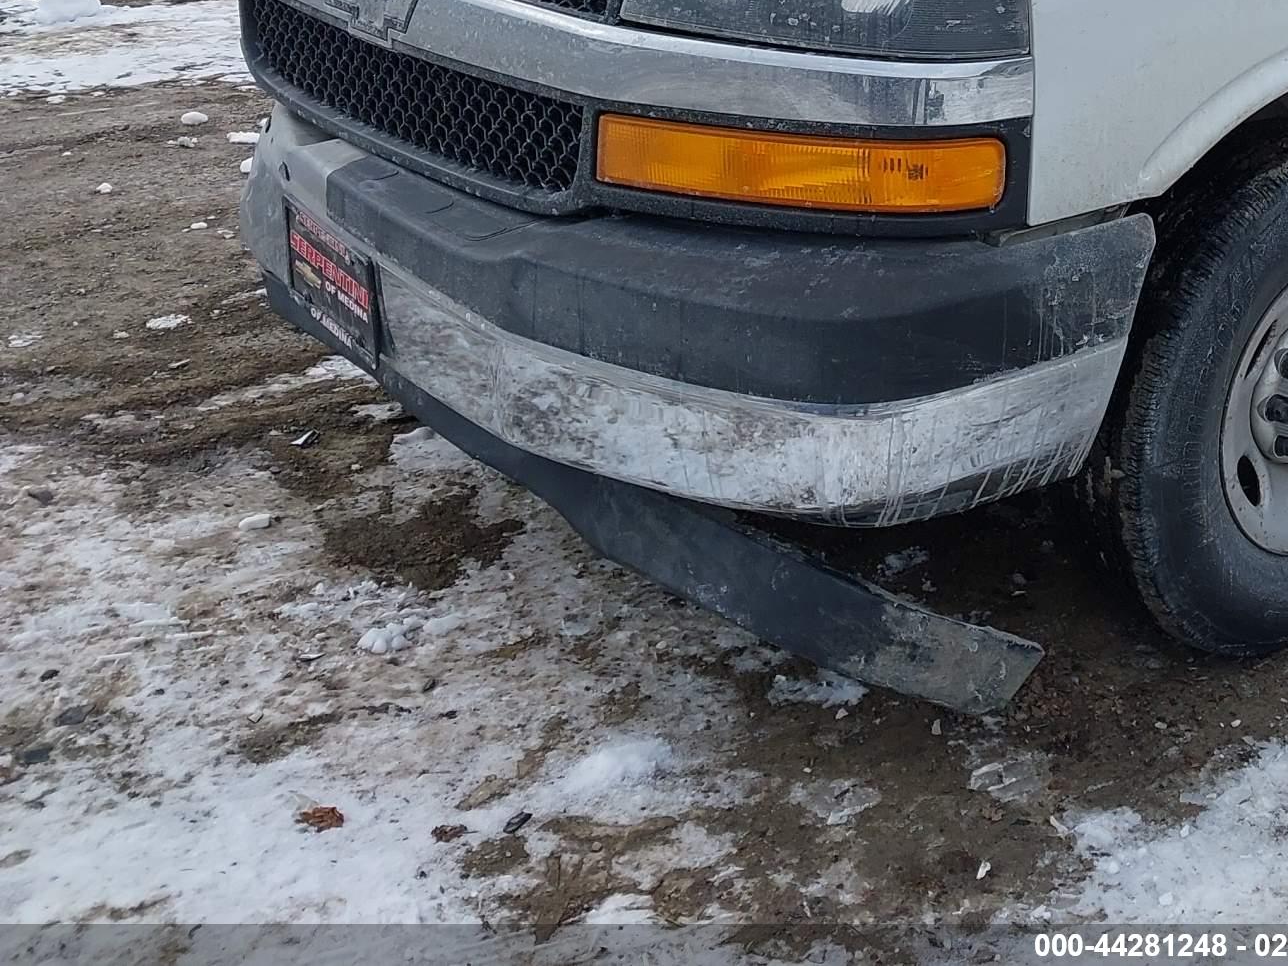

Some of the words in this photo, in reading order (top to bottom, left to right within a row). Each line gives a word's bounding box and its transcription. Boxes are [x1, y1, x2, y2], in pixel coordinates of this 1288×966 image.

[290, 229, 369, 310] SERPENTINI
[325, 281, 337, 295] OF
[337, 292, 369, 324] MEDINA
